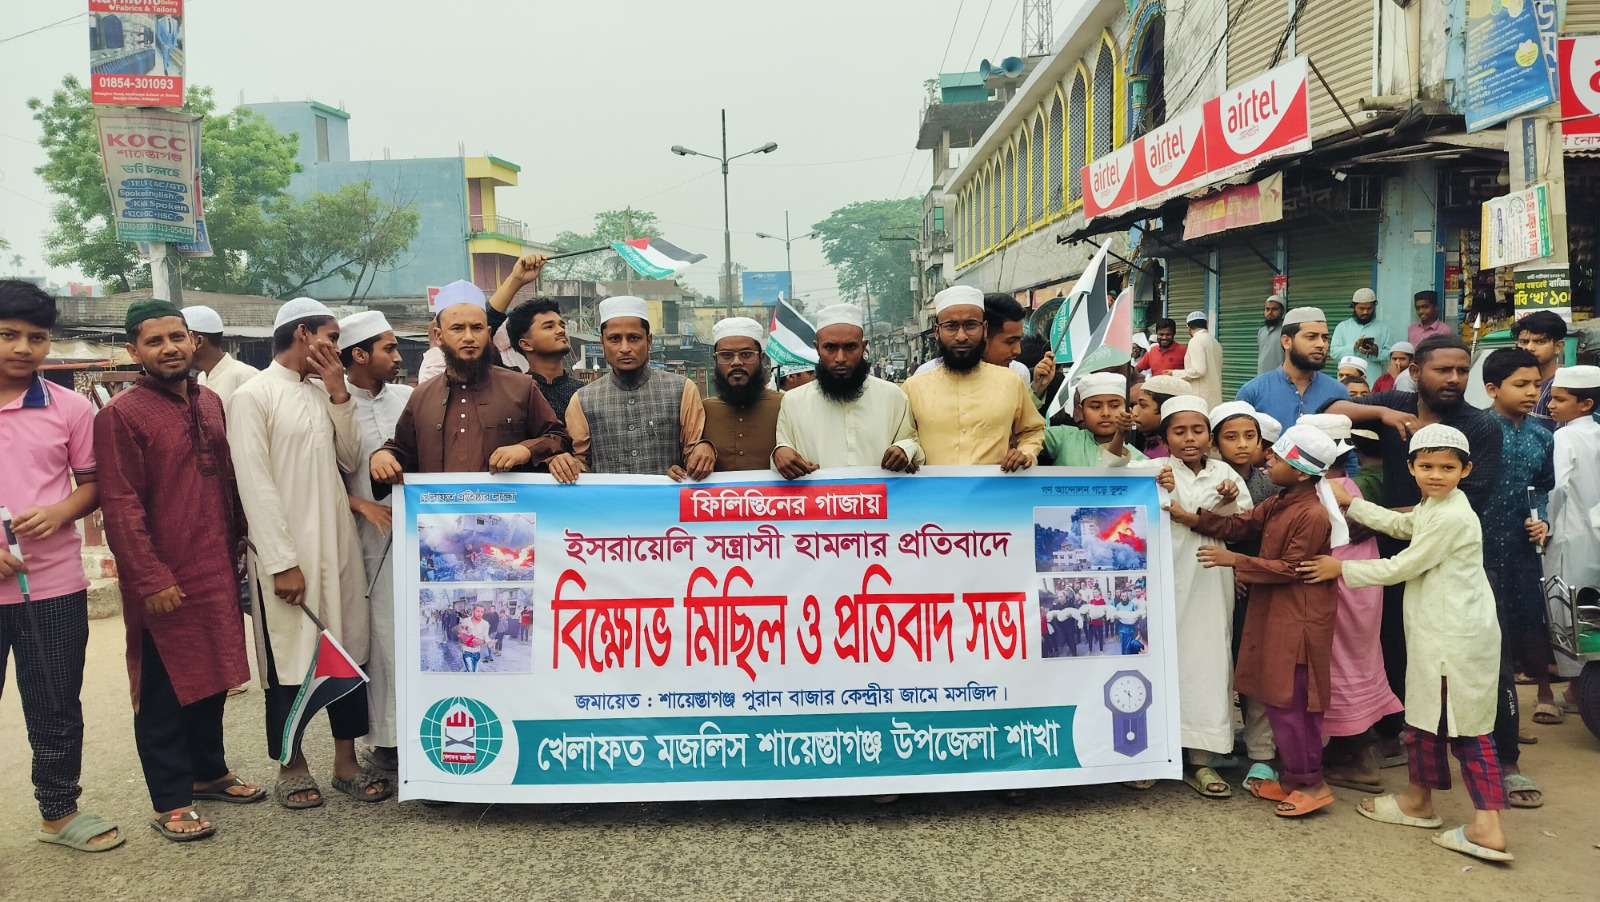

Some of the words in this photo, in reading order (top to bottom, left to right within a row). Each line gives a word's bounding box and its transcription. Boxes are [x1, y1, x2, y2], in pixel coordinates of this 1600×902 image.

[116, 4, 143, 12] Fabrics
[152, 5, 177, 13] Tailors
[99, 77, 174, 90] 01854-301093
[1228, 79, 1279, 134] airtel
[106, 133, 187, 152] KOCC
[1150, 124, 1186, 169] airtel
[145, 164, 181, 178] চলছে
[1093, 158, 1121, 193] airtel
[149, 181, 186, 192] (AC/GT)
[149, 200, 187, 212] Spoken
[690, 489, 808, 518] ফিলিস্তিনের
[815, 491, 883, 517] গাজায়
[1054, 485, 1090, 495] আন্দোলন
[563, 527, 697, 564] ইসরায়েলি
[703, 524, 785, 562] সন্ত্রাসী
[792, 530, 890, 561] হামলার
[898, 523, 1012, 560] প্রতিবাদে
[551, 569, 674, 673] বিক্ষোভ
[683, 565, 788, 682] মিছিল
[796, 594, 822, 665] ও
[833, 563, 955, 664] প্রতিবাদ
[962, 592, 1027, 661] সভা
[574, 692, 642, 711] জমায়েত
[657, 690, 736, 710] শায়েস্তাগঞ্জ
[742, 689, 784, 712] পুরান
[787, 688, 835, 707] বাজার
[841, 682, 894, 707] কেন্দ্রীয়
[899, 686, 939, 704] জামে
[943, 681, 999, 702] মসজিদ
[537, 731, 649, 772] খেলাফত
[653, 721, 750, 769] মজলিস
[755, 725, 883, 768] শায়েস্তাগঞ্জ
[889, 717, 999, 762] উপজেলা
[1004, 718, 1061, 758] শাখা
